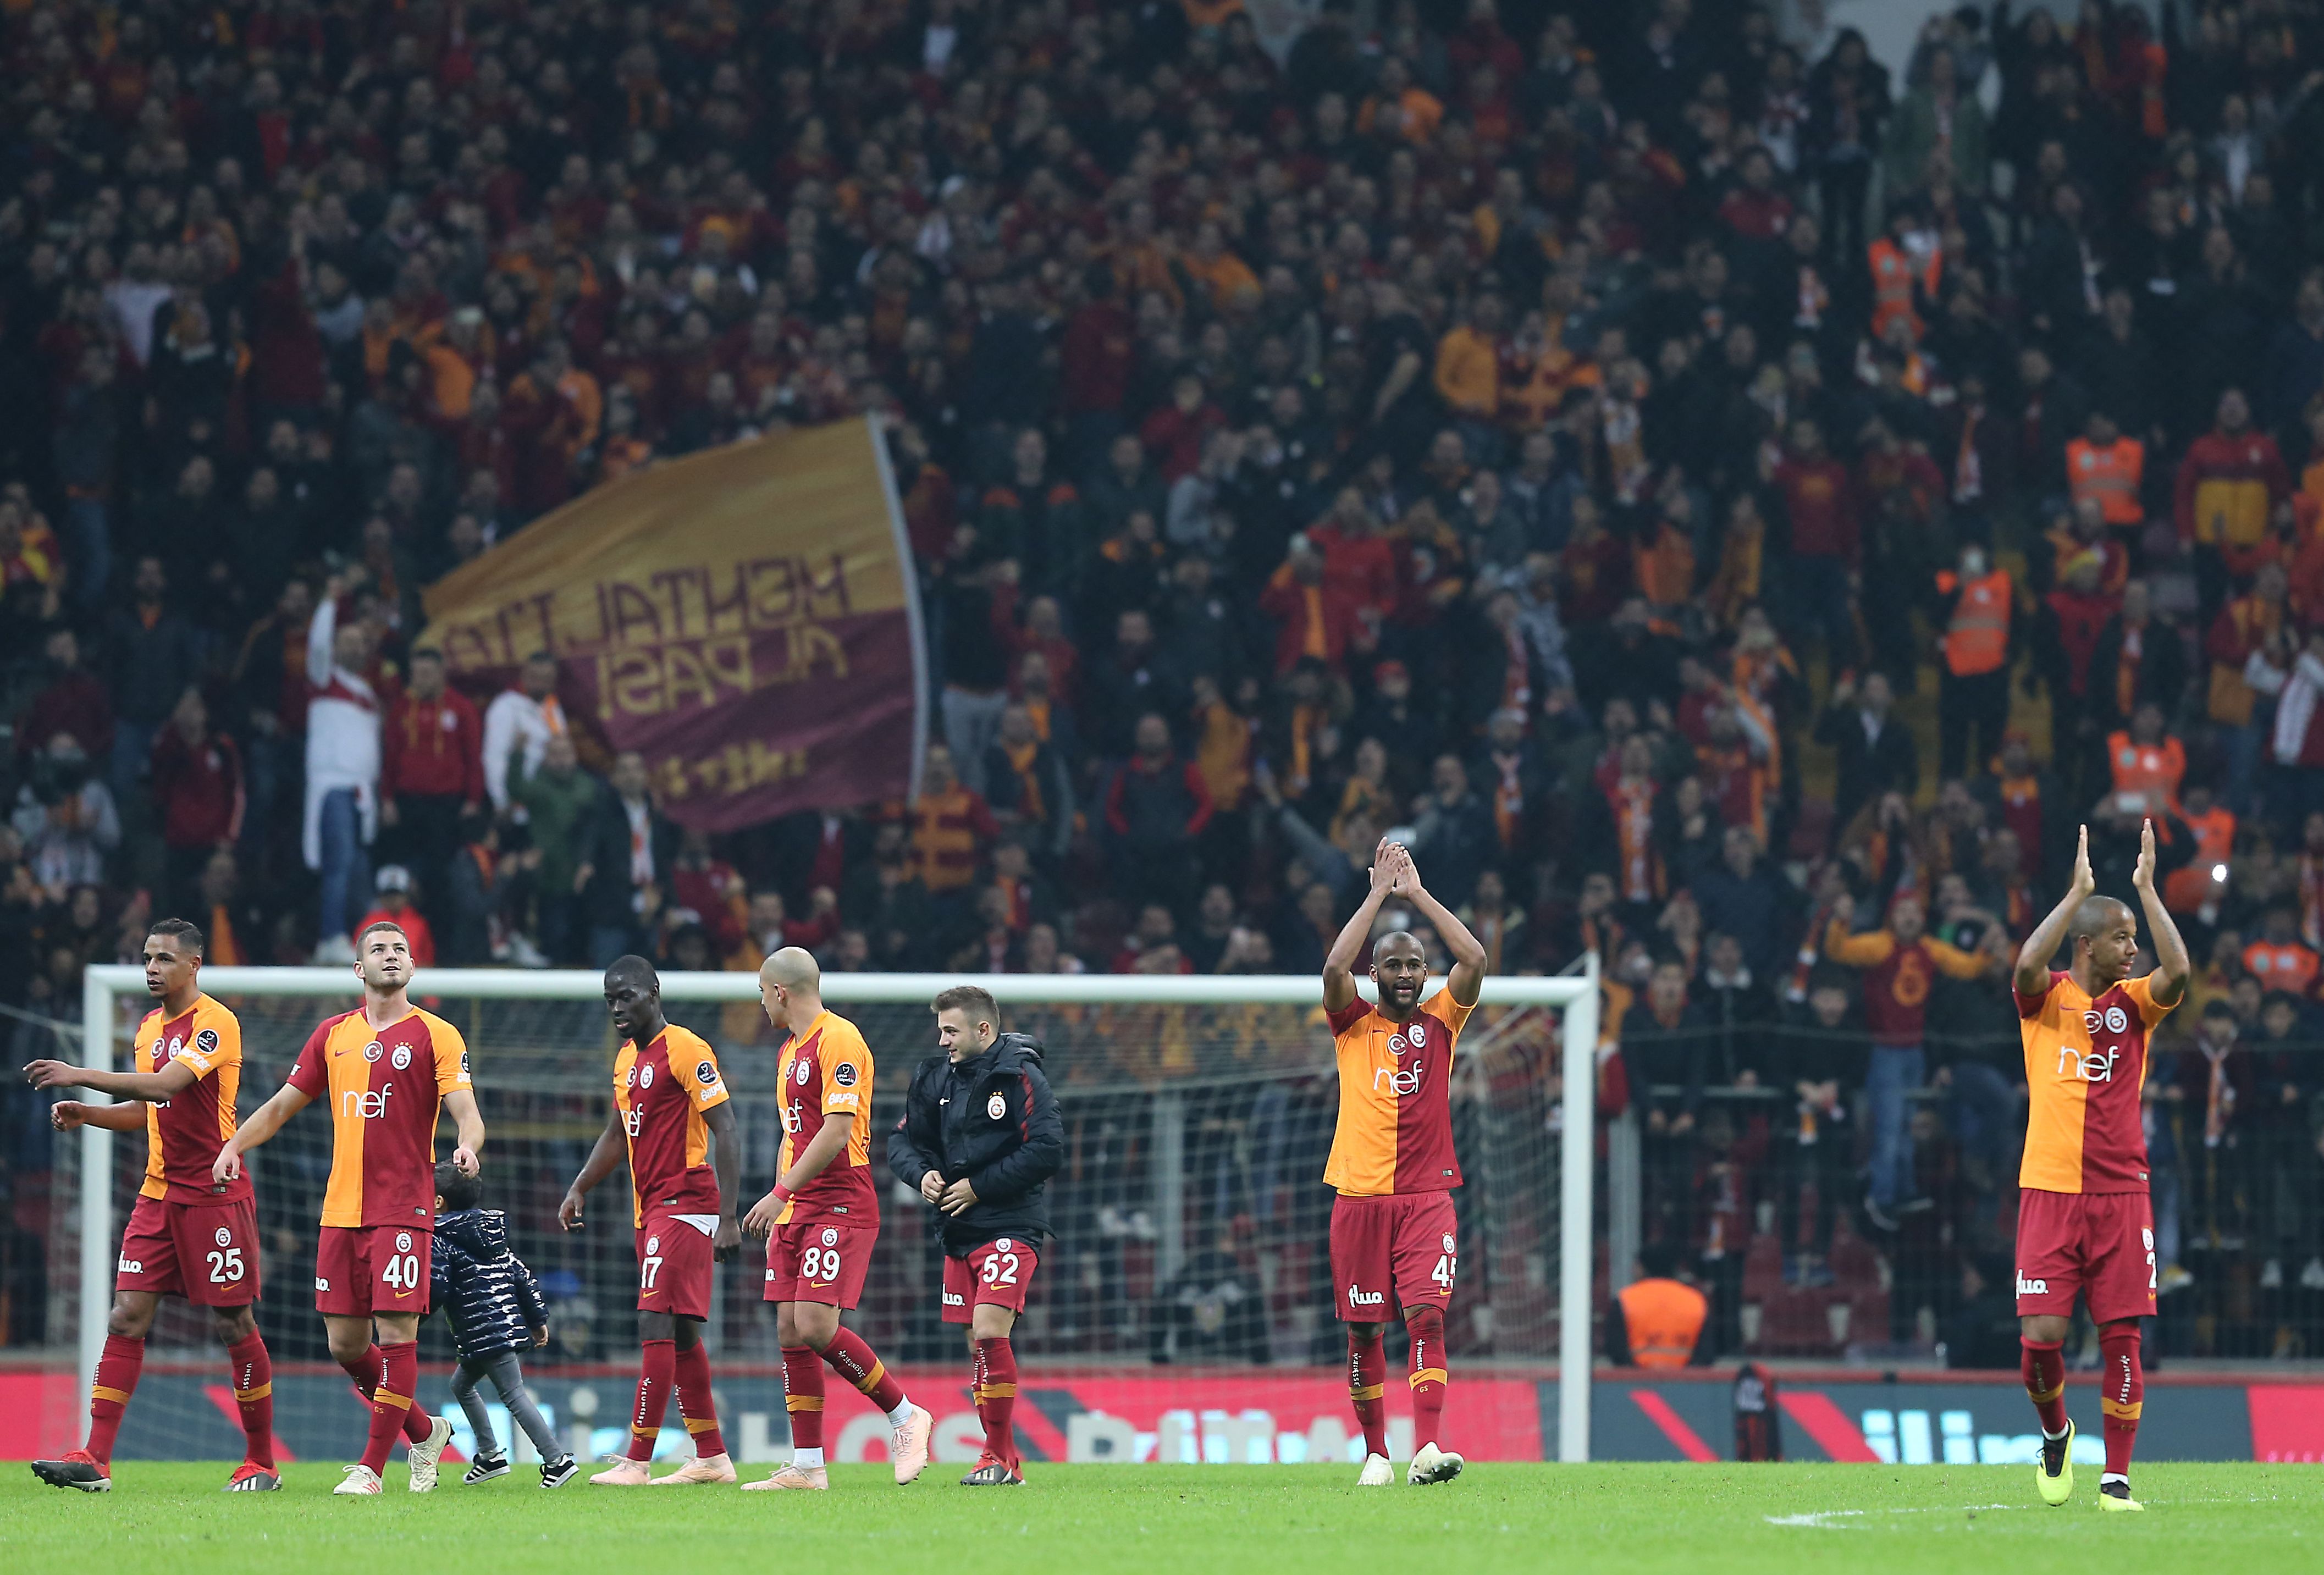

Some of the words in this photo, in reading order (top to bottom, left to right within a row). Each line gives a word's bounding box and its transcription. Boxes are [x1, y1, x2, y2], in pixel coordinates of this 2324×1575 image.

[1373, 1060, 1423, 1095] nef
[2058, 1046, 2120, 1082] nef
[343, 1082, 393, 1118] nef
[207, 1248, 244, 1283] 25
[382, 1255, 419, 1289] 40
[803, 1247, 840, 1281] 89
[982, 1253, 1019, 1284] 52
[242, 1363, 252, 1390] UNESSE
[637, 1386, 647, 1426] JEUNESSE
